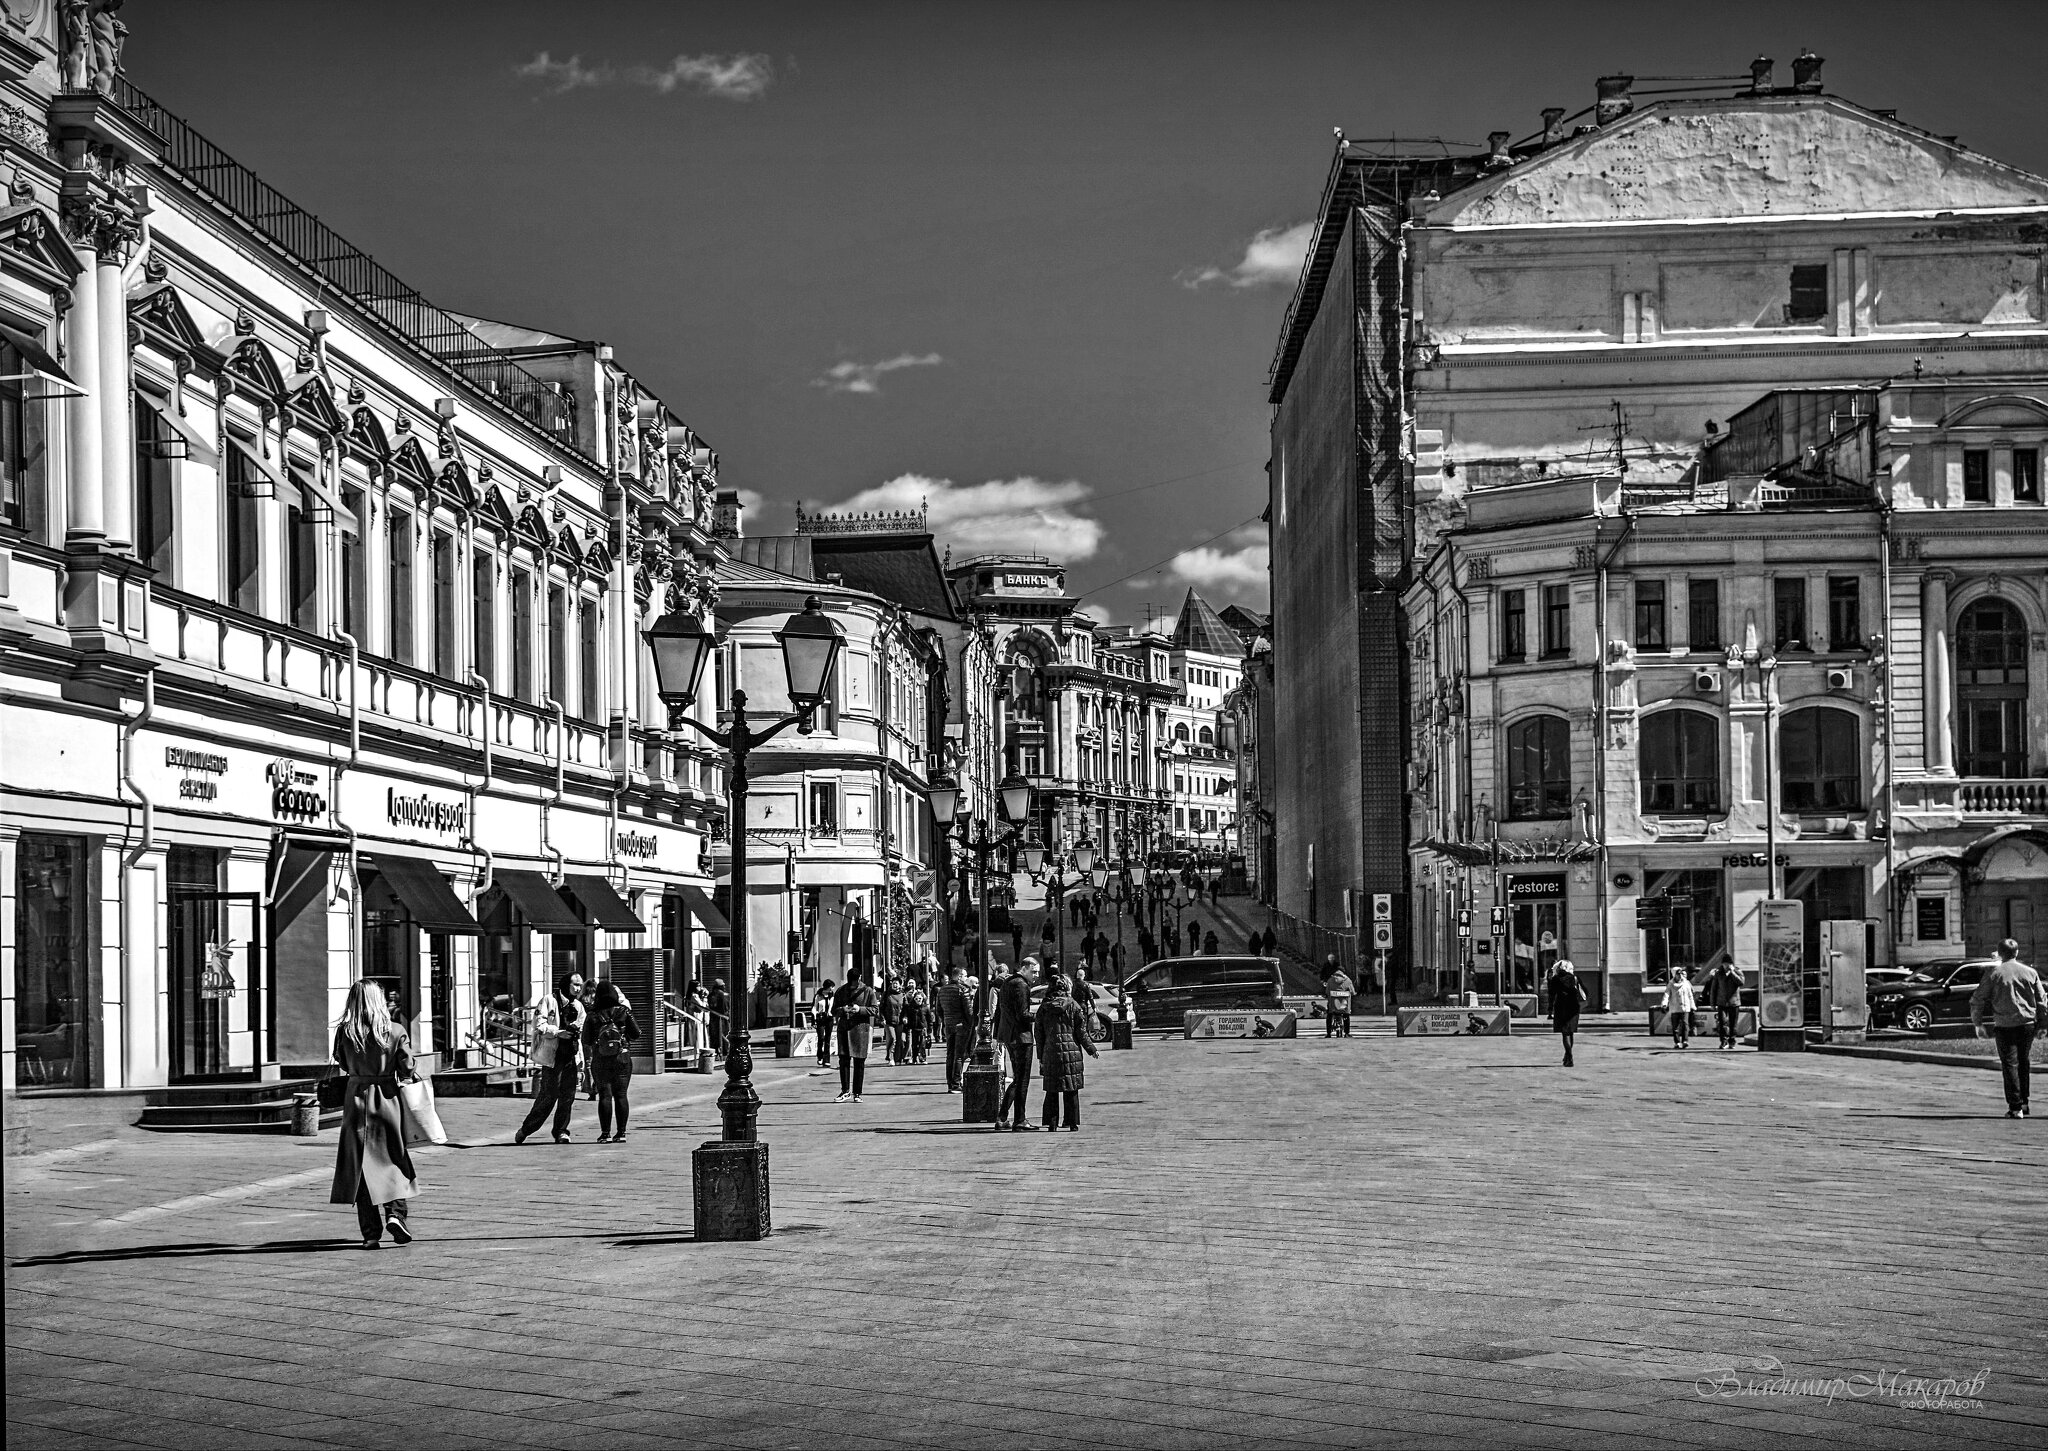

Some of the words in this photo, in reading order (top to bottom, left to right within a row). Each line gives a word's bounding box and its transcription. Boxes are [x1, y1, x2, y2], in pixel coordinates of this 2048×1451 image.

[1007, 574, 1047, 585] БАНКЪ
[165, 747, 228, 775] БРИЛЛИАНТЫ
[275, 789, 321, 816] COLON
[388, 787, 439, 830] lamoda
[1722, 853, 1790, 868] restoe:
[1513, 882, 1559, 893] restore:
[201, 972, 220, 988] 80
